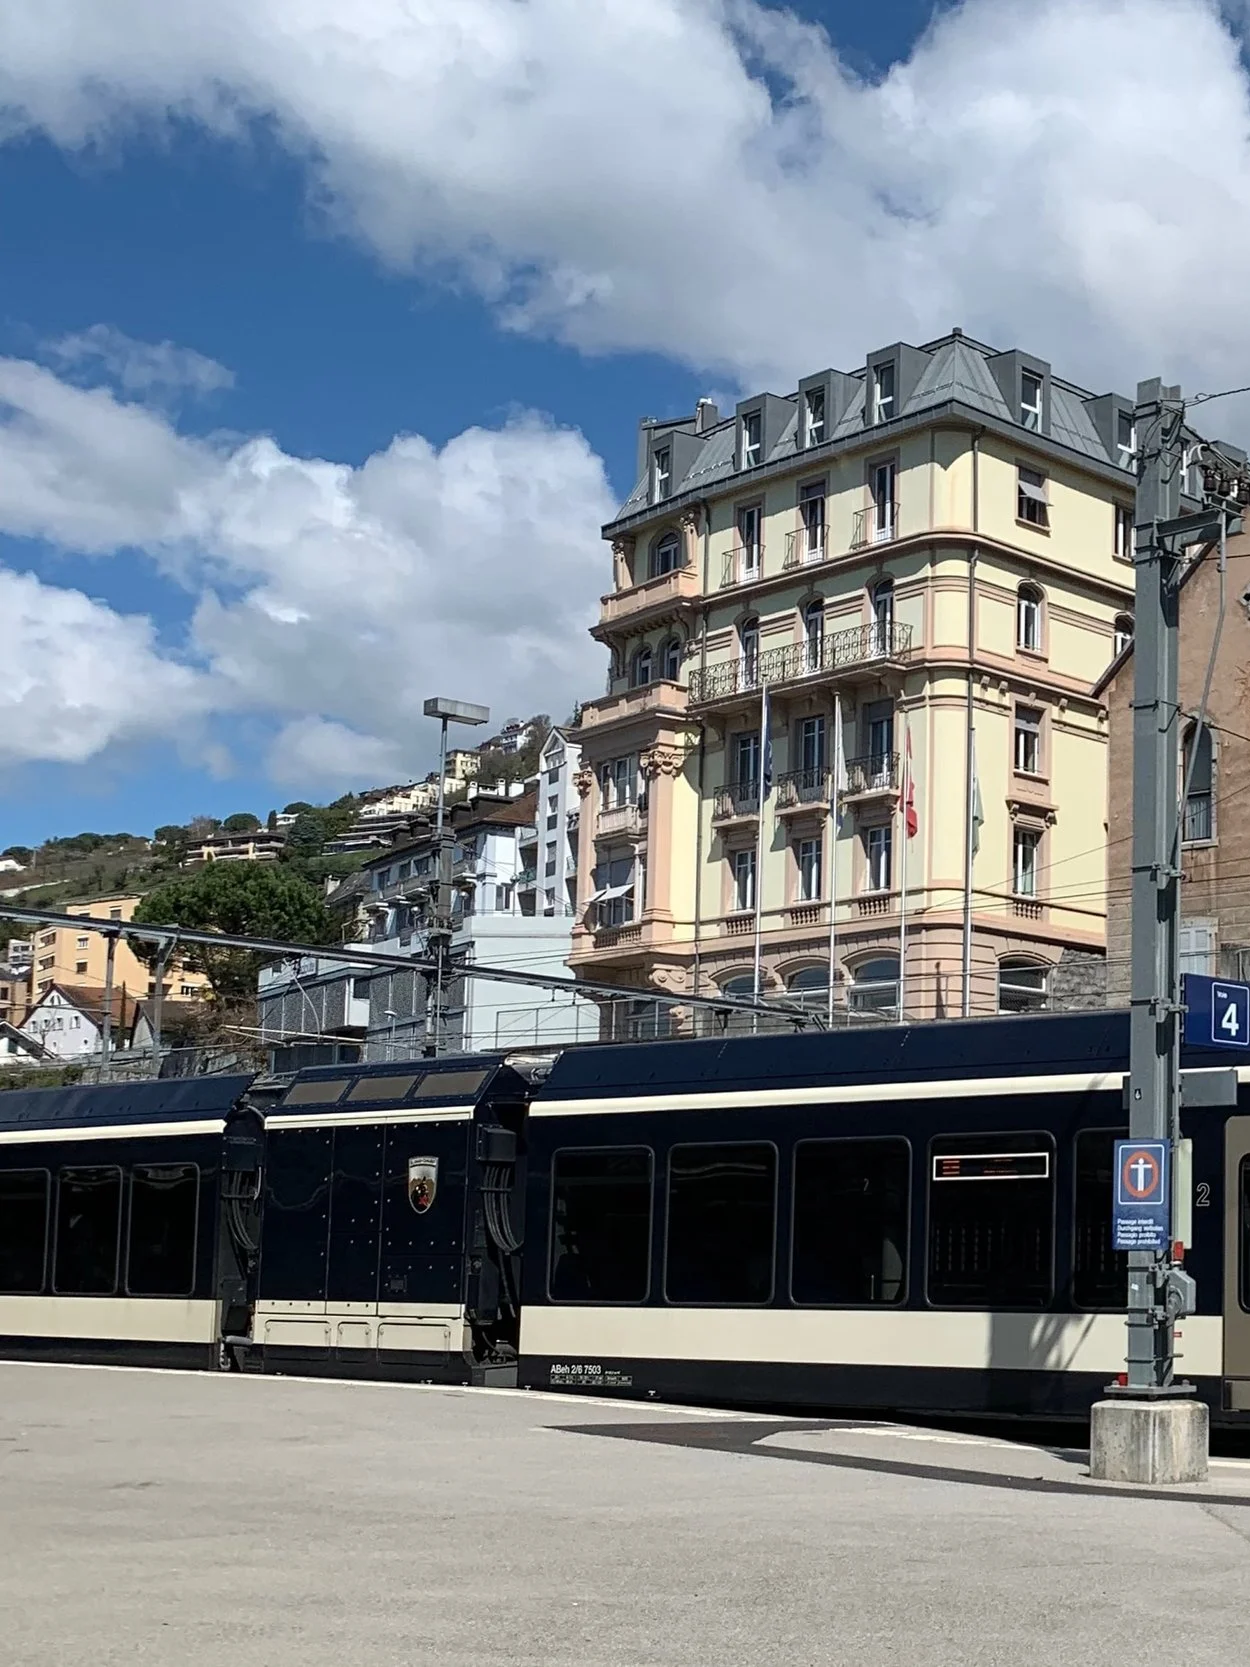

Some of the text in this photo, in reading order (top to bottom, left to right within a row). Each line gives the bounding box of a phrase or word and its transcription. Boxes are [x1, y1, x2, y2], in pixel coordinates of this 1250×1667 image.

[1221, 1002, 1240, 1037] 4
[1196, 1182, 1210, 1207] 2
[550, 1364, 570, 1374] ABeh
[584, 1364, 602, 1375] 7503
